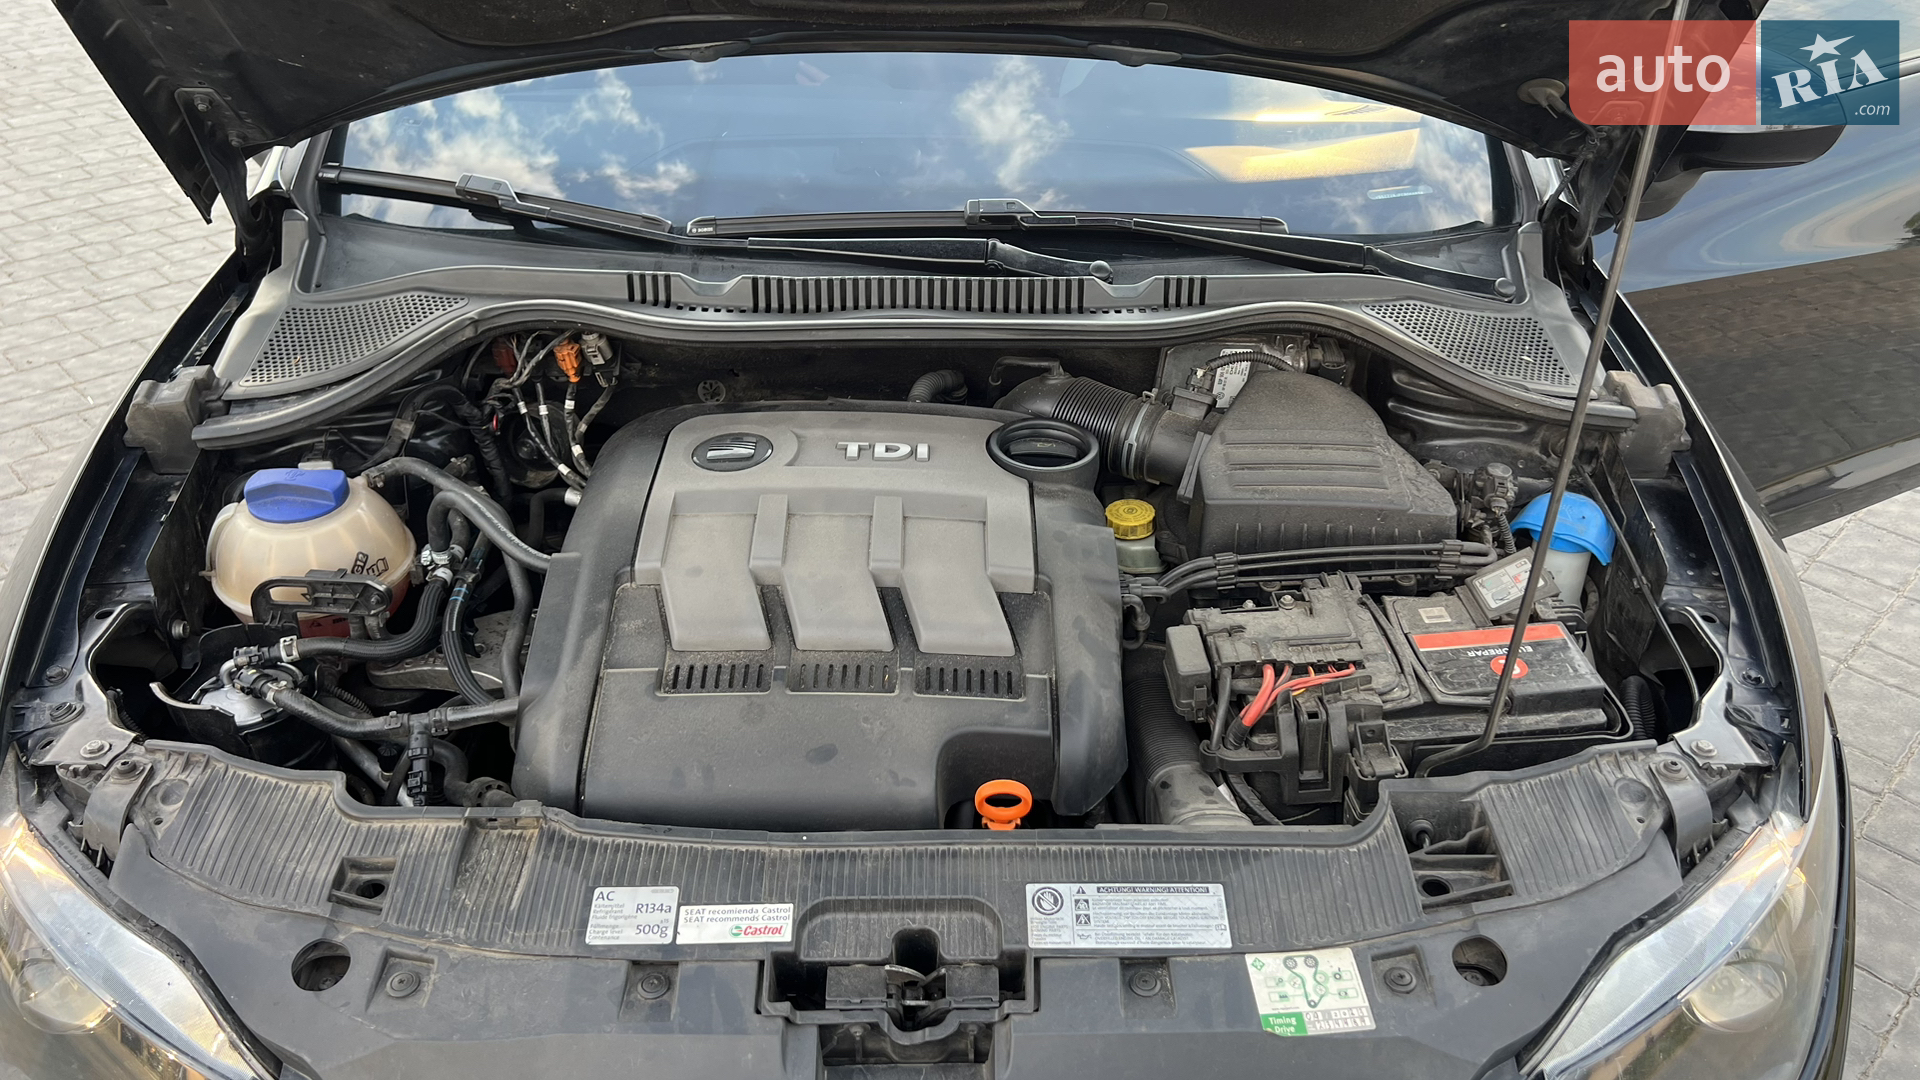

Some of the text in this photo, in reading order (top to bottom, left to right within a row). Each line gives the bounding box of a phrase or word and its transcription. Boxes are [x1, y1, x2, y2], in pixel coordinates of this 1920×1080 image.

[836, 441, 930, 462] TDI
[354, 552, 367, 575] G12
[595, 891, 615, 901] AC
[635, 902, 672, 914] R134a
[685, 906, 791, 916] SEAT recomienda Castrol
[635, 924, 669, 938] 500g
[743, 925, 783, 936] Castrol
[1268, 1016, 1297, 1026] Timing
[1274, 1025, 1295, 1034] Drive
